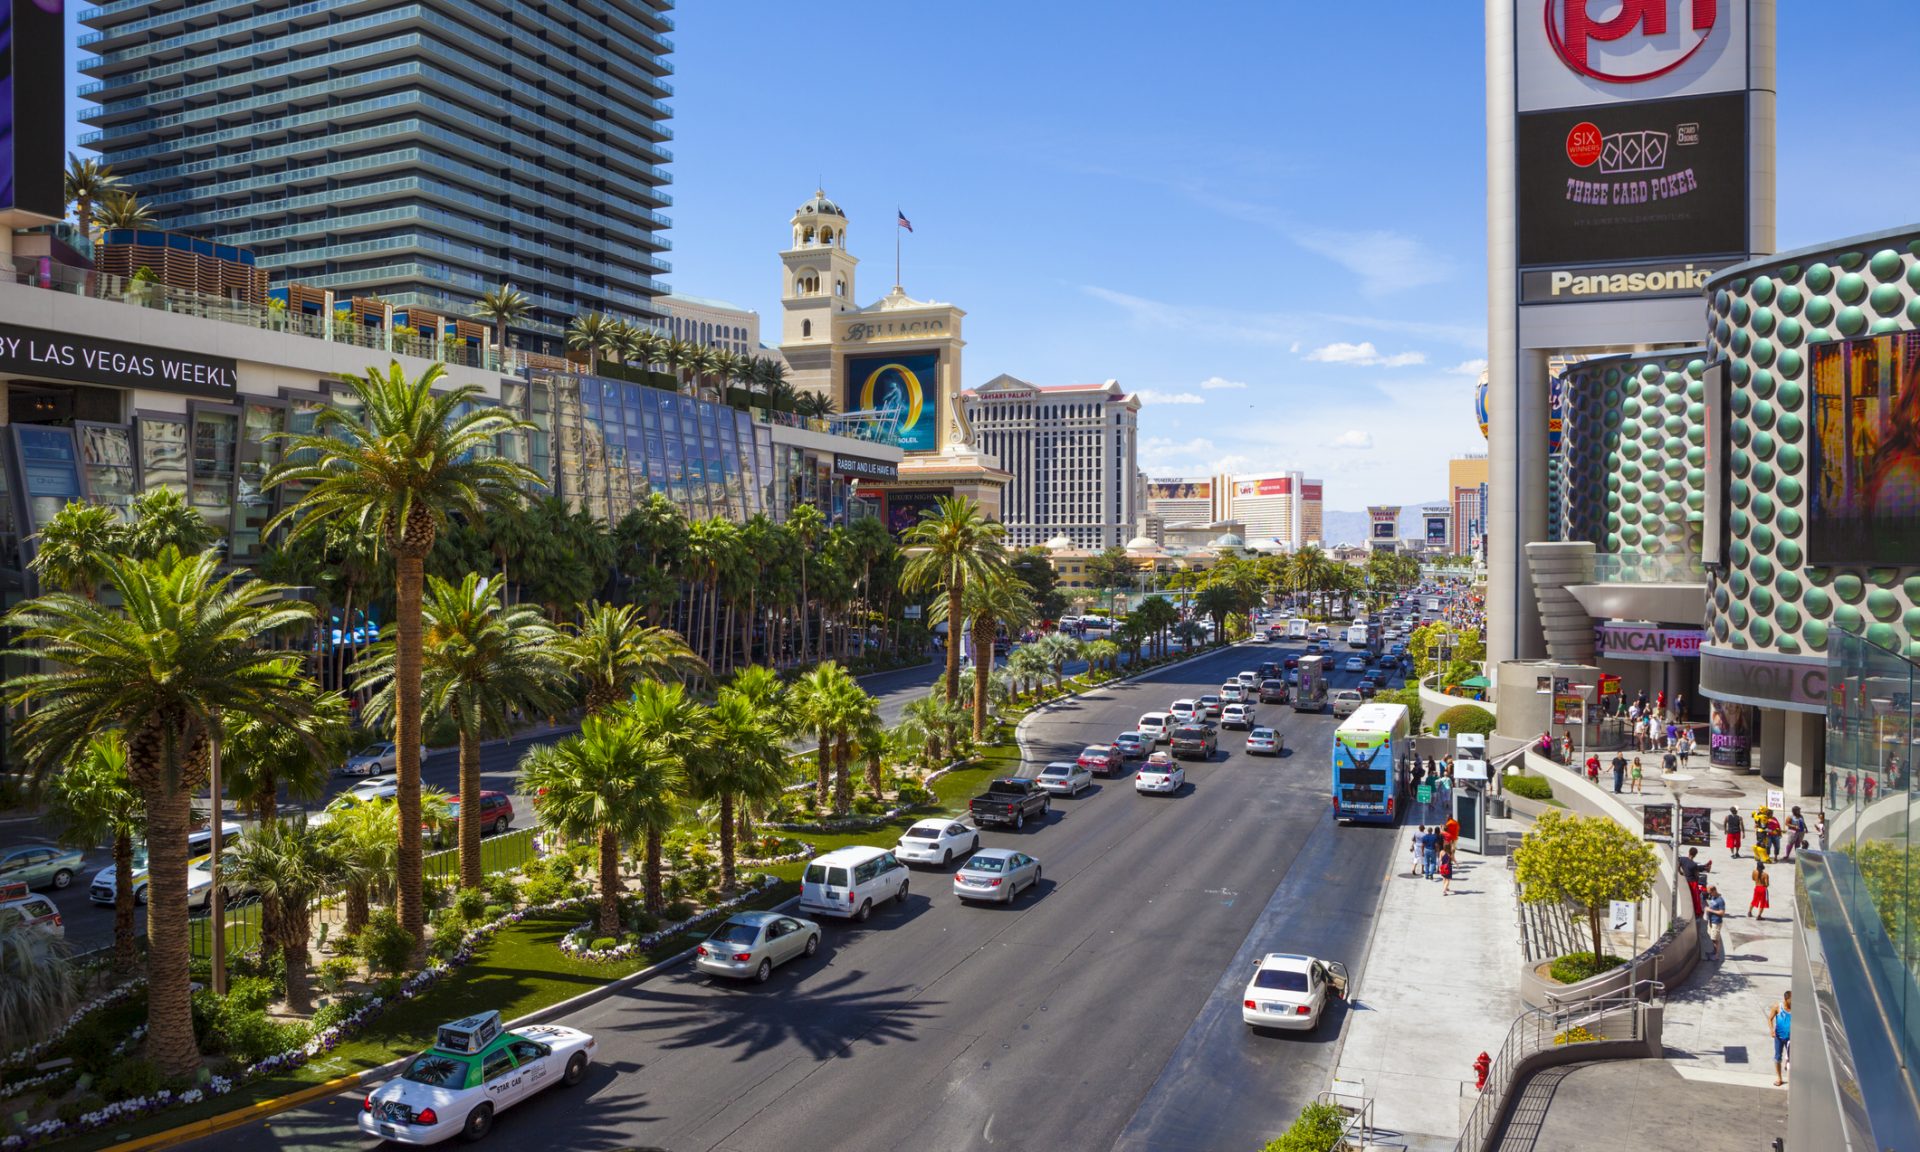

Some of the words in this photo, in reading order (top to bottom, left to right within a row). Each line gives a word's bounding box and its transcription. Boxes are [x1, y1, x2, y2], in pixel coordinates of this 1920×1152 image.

[1573, 131, 1595, 146] SIX
[1566, 178, 1609, 205] THREE
[1612, 181, 1648, 204] CARD
[1651, 168, 1697, 200] POKER
[1552, 264, 1711, 296] Panasonic
[30, 341, 75, 366] LAS
[82, 348, 155, 376] VEGAS
[838, 458, 856, 471] RABBIT
[857, 461, 868, 473] AND
[877, 465, 889, 475] HAVE
[496, 1082, 510, 1093] STAR
[511, 1077, 522, 1087] CAB
